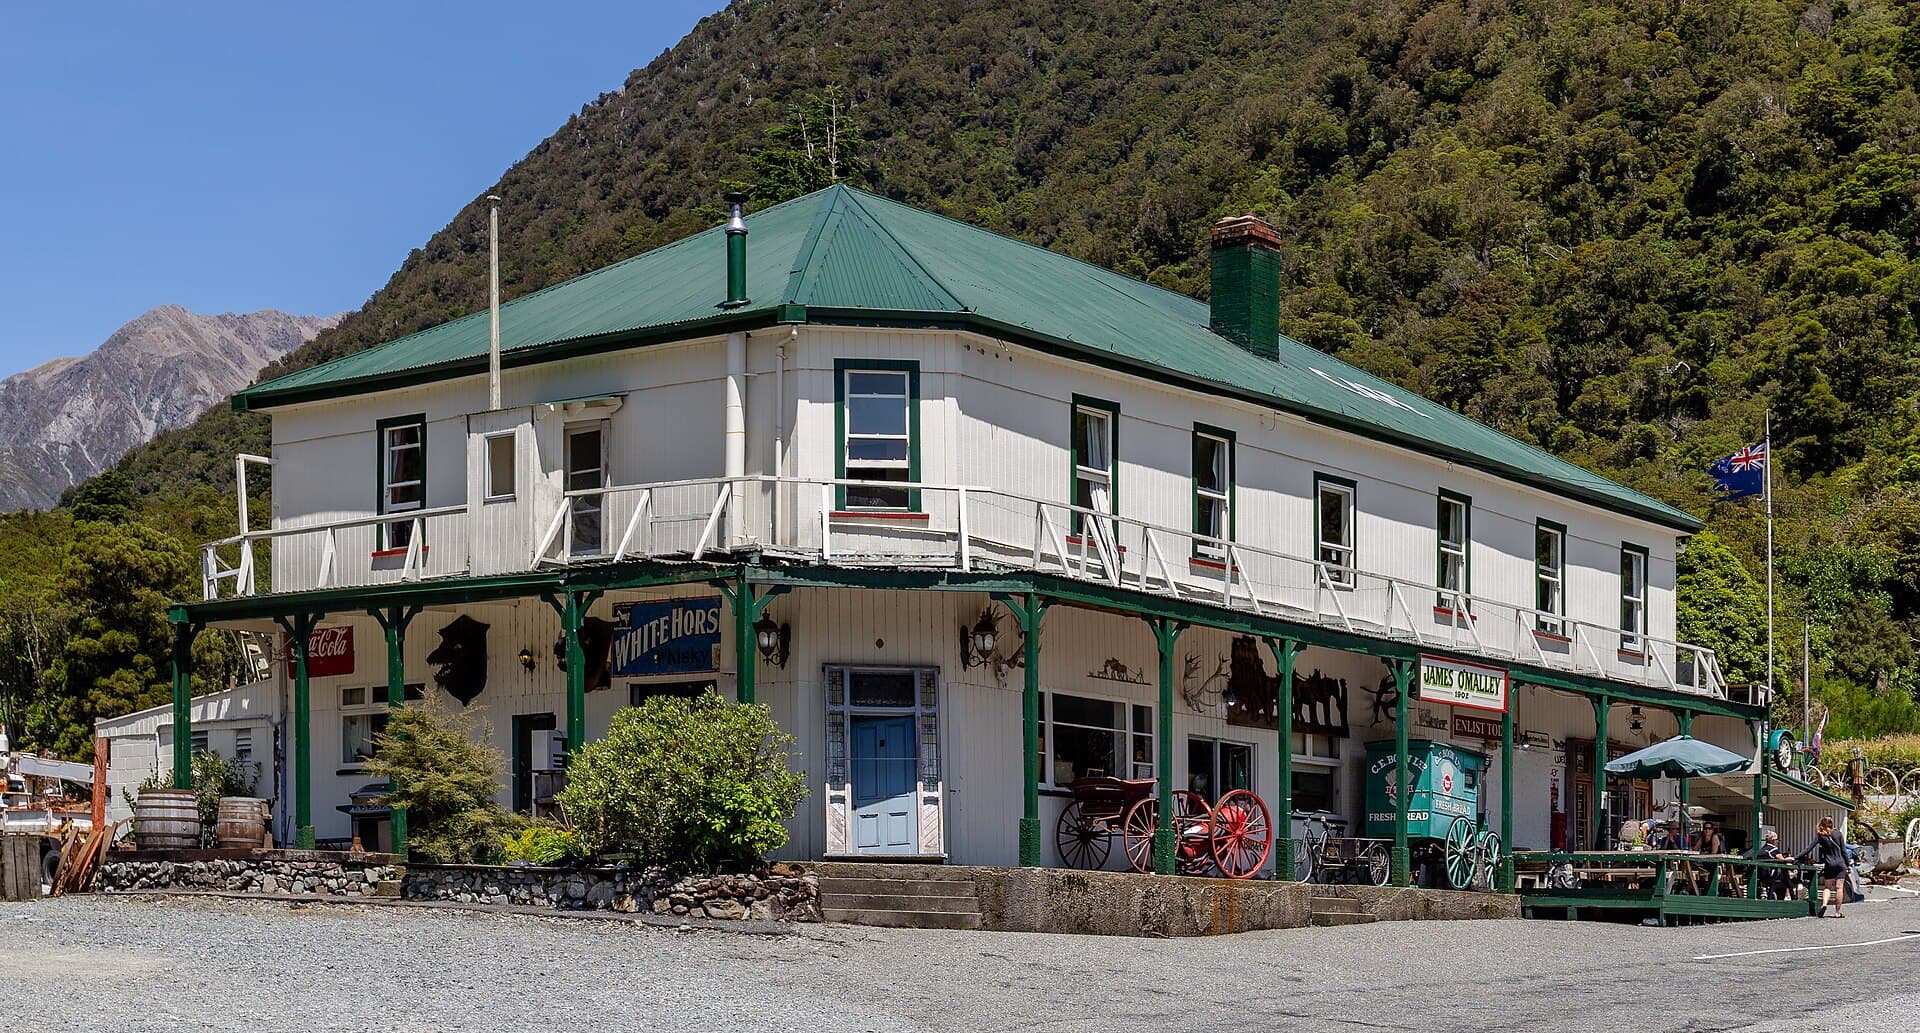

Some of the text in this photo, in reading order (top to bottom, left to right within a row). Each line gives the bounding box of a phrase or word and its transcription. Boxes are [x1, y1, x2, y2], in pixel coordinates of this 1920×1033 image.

[615, 615, 669, 672] WHITE
[1424, 665, 1501, 696] JAMES O'MALLEY
[1455, 690, 1469, 699] 1902
[1455, 718, 1486, 735] ENLIST
[1435, 800, 1452, 811] FRESH
[1369, 812, 1396, 821] FRESH
